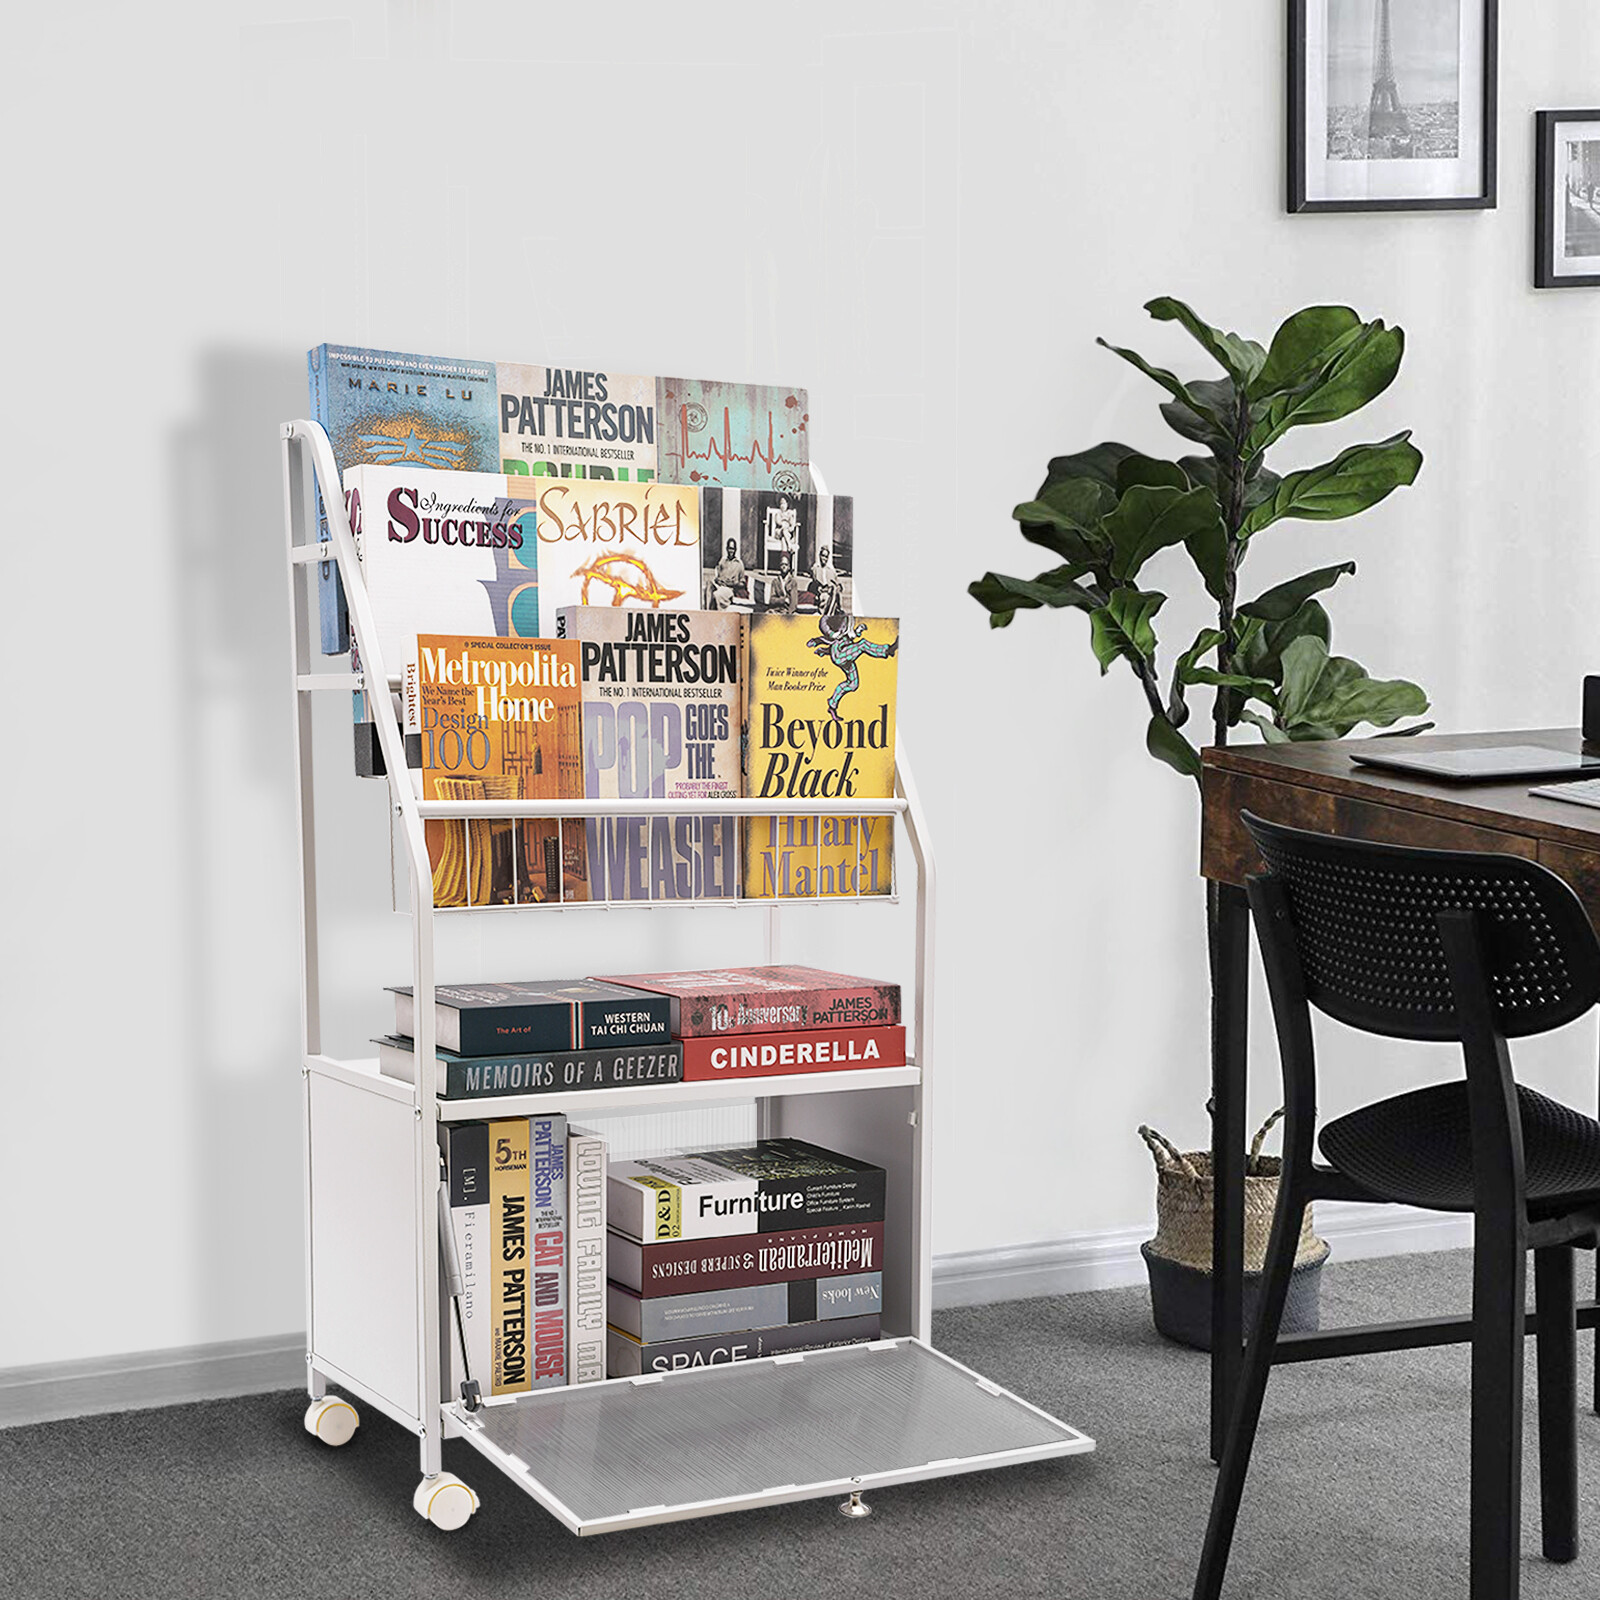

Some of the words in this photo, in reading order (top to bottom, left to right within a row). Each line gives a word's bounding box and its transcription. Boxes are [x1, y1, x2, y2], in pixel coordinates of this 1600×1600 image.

[418, 362, 433, 370] EVEN
[434, 363, 457, 373] HARDER
[467, 367, 489, 376] FORGET
[544, 367, 608, 402] JAMES
[349, 377, 427, 396] MARIE
[446, 388, 473, 401] LU
[500, 394, 654, 445] PATTERSON
[521, 442, 533, 454] THE
[534, 443, 547, 455] NO.
[547, 444, 552, 455] 1
[553, 445, 599, 458] INTERNATIONAL
[600, 448, 635, 461] BESTSELLER
[387, 487, 524, 549] SUCCESS
[419, 491, 500, 519] Ingredients
[500, 499, 521, 523] for
[624, 612, 690, 643] JAMES
[496, 642, 533, 650] COLLECTOR'S
[535, 643, 551, 651] ISSUE
[582, 641, 737, 685] PATTERSON
[420, 647, 578, 697] Metropolita
[766, 667, 785, 677] Twice
[786, 667, 810, 677] Winner
[810, 667, 819, 680] of
[818, 667, 828, 677] the
[767, 681, 783, 691] Man
[784, 681, 808, 691] Booker
[808, 681, 826, 691] Prize
[406, 663, 417, 727] Brightest
[421, 686, 435, 695] We
[436, 686, 460, 696] Name
[461, 686, 475, 697] the
[422, 695, 447, 706] Year's
[448, 696, 466, 706] Best
[476, 686, 555, 723] Home
[599, 687, 612, 698] THE
[613, 687, 626, 698] NO.
[626, 687, 630, 697] 1
[632, 687, 682, 698] INTERNATIONAL
[683, 688, 723, 699] BESTSELLER
[423, 708, 489, 734] Design
[685, 703, 729, 742] GOES
[760, 702, 888, 765] Beyond
[423, 729, 491, 771] 100
[584, 702, 682, 798] POP
[685, 743, 715, 780] THE
[757, 751, 859, 798] Black
[765, 816, 879, 861] Hilary
[585, 816, 741, 900] WEASEL
[759, 848, 881, 897] Mantel
[604, 1012, 651, 1024] WESTERN
[813, 1008, 888, 1025] PATTERSON
[828, 997, 873, 1011] JAMES
[510, 1026, 521, 1034] Art
[590, 1025, 607, 1036] TAI
[609, 1024, 628, 1035] CHI
[629, 1022, 665, 1035] CHUAN
[710, 1039, 881, 1070] CINDERELLA
[465, 1060, 555, 1091] MEMOIRS
[563, 1060, 585, 1084] OF
[593, 1060, 604, 1083] A
[613, 1054, 679, 1081] GEEZER
[496, 1138, 527, 1164] 5TH
[535, 1120, 552, 1208] PATTERSON
[551, 1144, 564, 1181] JAMES
[699, 1191, 805, 1217] Furniture
[502, 1194, 525, 1262] JAMES
[464, 1211, 475, 1320] Fieramilano
[535, 1231, 564, 1267] CAT
[701, 1254, 741, 1274] SUPERB
[758, 1236, 874, 1274] Mediterranean
[652, 1259, 697, 1279] DESIGNS
[535, 1272, 559, 1308] AND
[822, 1286, 852, 1304] looks
[854, 1282, 880, 1300] New
[502, 1267, 526, 1387] PATTERSON
[535, 1309, 564, 1381] MOUSE
[651, 1344, 748, 1372] SPACE
